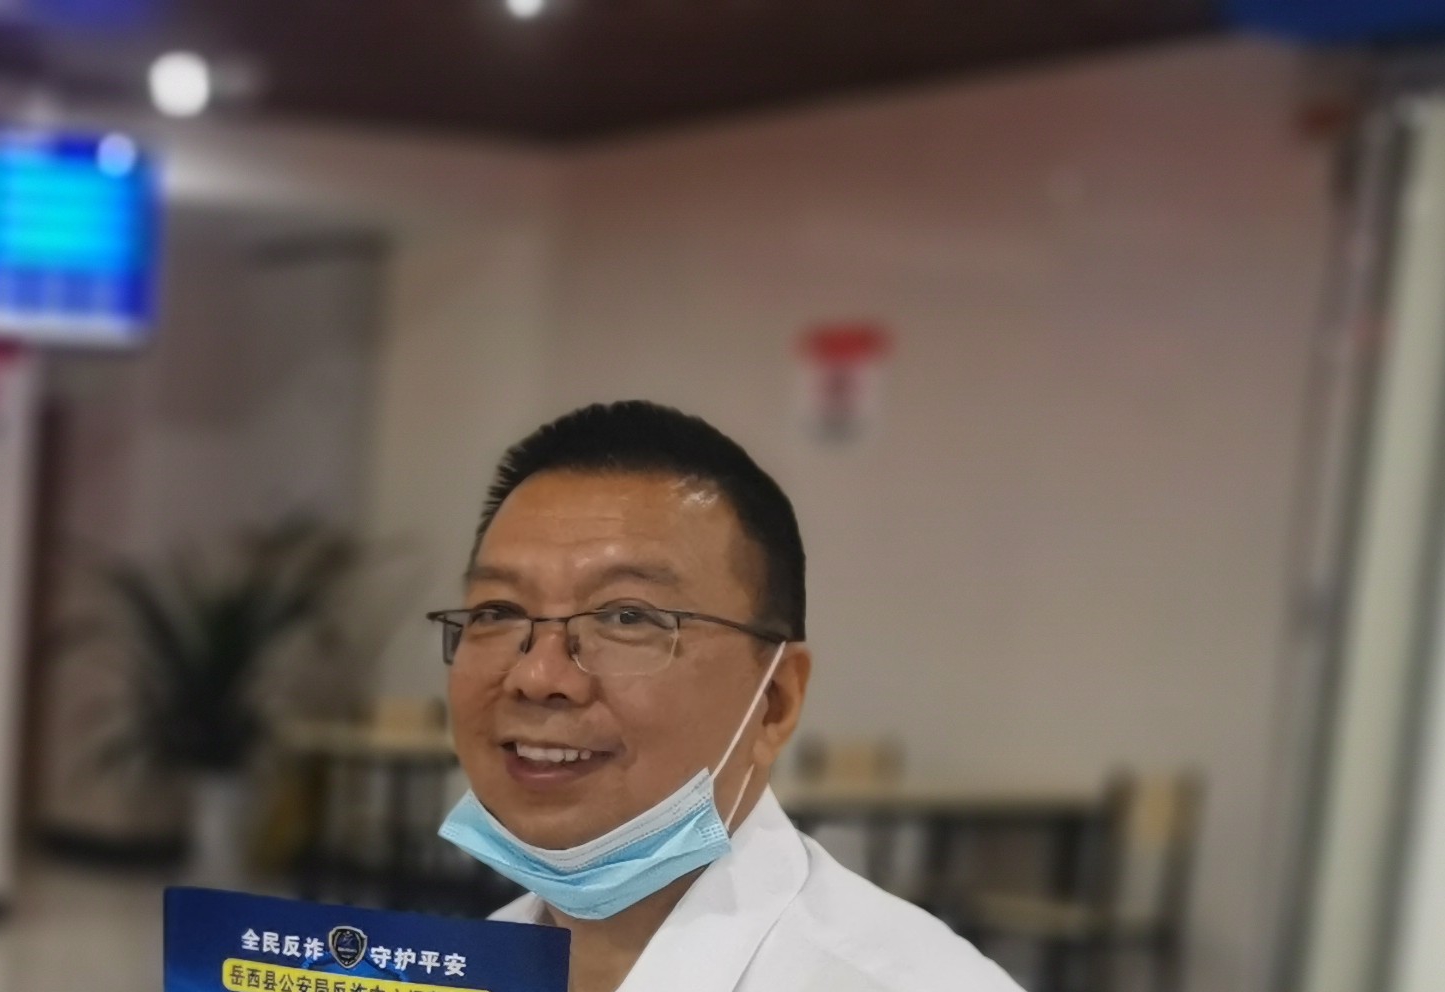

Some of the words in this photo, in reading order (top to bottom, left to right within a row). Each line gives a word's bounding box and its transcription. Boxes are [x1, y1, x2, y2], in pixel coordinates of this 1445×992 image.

[241, 928, 325, 960] 全民反诈
[369, 946, 467, 977] 守护平安
